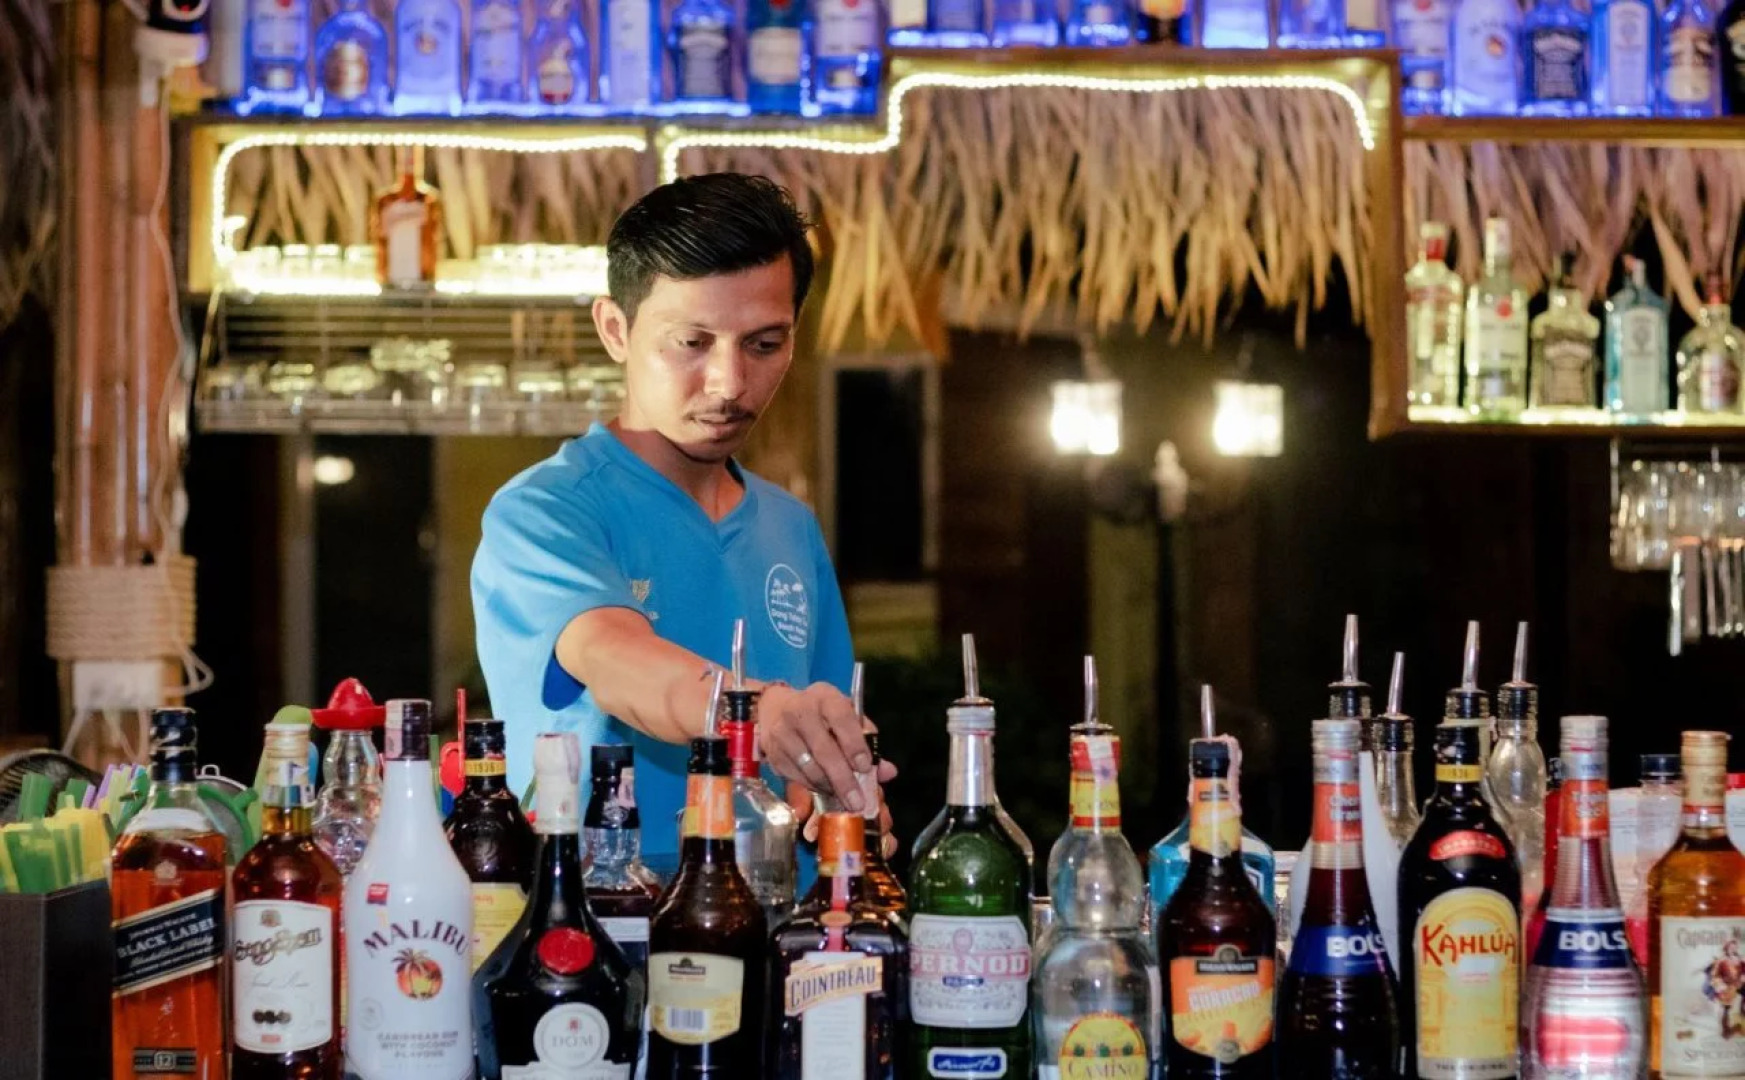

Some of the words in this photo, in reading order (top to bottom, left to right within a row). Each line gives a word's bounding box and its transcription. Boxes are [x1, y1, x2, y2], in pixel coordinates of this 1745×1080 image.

[117, 934, 167, 958] BLACK
[169, 917, 215, 941] LABEL
[363, 919, 469, 959] MALIBU
[1327, 931, 1385, 958] BOLS
[1559, 930, 1629, 952] BOLS
[1676, 927, 1726, 950] Captain
[910, 951, 1027, 974] PERNOD
[791, 966, 876, 1008] COINTREAU
